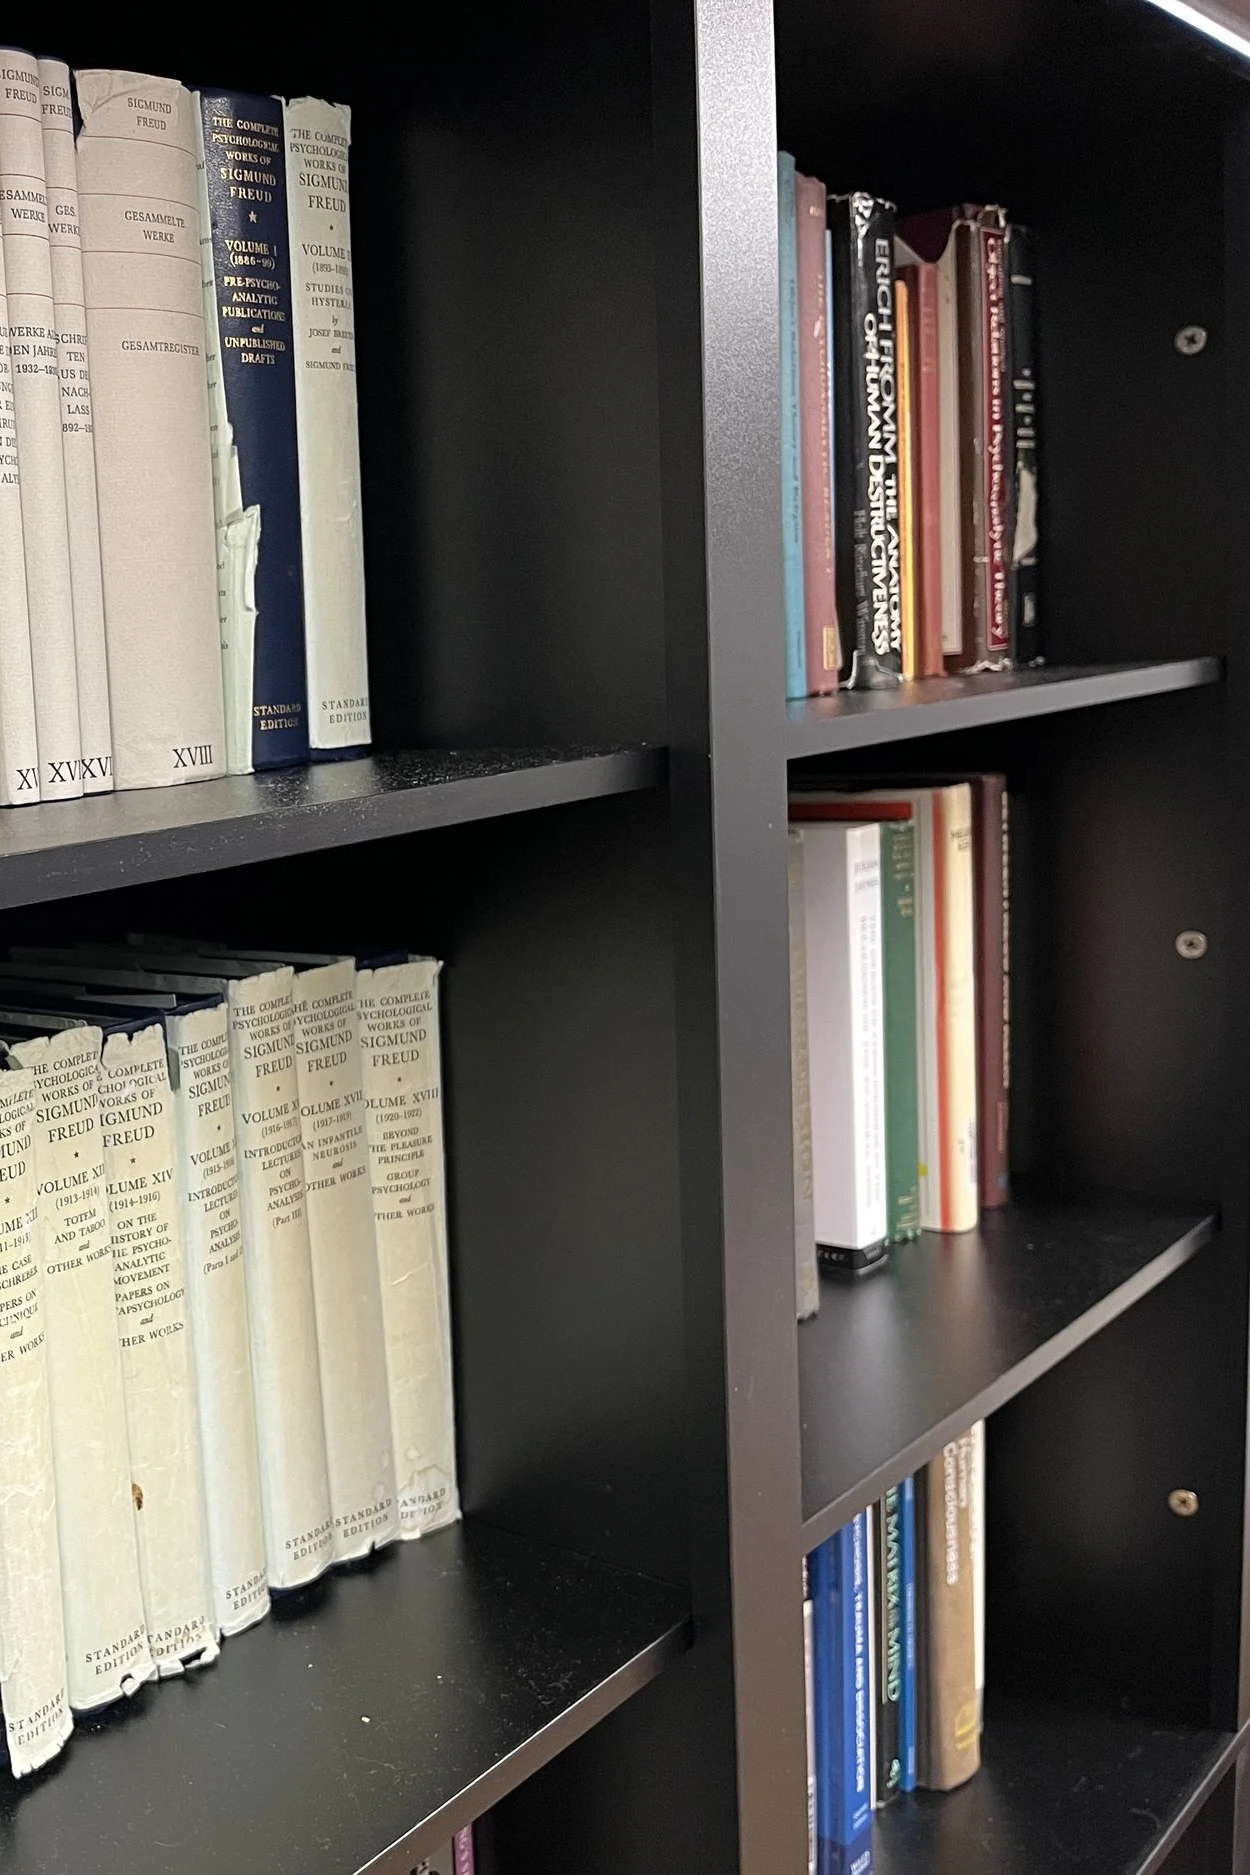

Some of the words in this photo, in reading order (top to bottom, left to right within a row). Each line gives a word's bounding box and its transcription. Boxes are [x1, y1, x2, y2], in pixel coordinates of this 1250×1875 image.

[5, 88, 37, 104] FREUD
[127, 98, 172, 114] SIGMUND
[136, 116, 166, 130] FREUD
[212, 117, 233, 128] THE
[237, 119, 279, 137] COMPLETE
[220, 167, 276, 186] SIGMUND
[230, 186, 272, 203] FREUD
[308, 195, 346, 213] FREUD
[125, 210, 185, 228] GESAMMELTE
[143, 229, 174, 243] WERKE
[225, 240, 270, 255] VOLUME
[875, 238, 893, 331] ERICH
[232, 292, 278, 305] ANALYTIC
[122, 340, 200, 356] GESAMTREGISTER
[225, 337, 285, 351] UNPUBLISHED
[242, 353, 275, 364] DRAFTS
[864, 350, 881, 450] HUMAN
[879, 339, 897, 464] FROMM
[67, 405, 90, 415] LASS
[884, 476, 898, 521] THE
[868, 455, 890, 655] DESTRUCTIVENESS
[254, 704, 301, 717] STANDARD
[330, 712, 367, 724] EDITION
[260, 718, 298, 730] EDITION
[172, 745, 213, 768] XVIII
[360, 1029, 427, 1048] SIGMUND
[372, 1049, 420, 1067] FREUD
[313, 1141, 357, 1161] NEUROSIS
[378, 1151, 425, 1165] PRINCIPLE
[64, 1208, 97, 1227] TOTEM
[54, 1231, 76, 1245] AND
[78, 1218, 106, 1237] TABOO
[114, 1252, 166, 1272] ANALYTIC
[343, 1513, 389, 1538] EDITION
[887, 1513, 899, 1609] MATRIX
[888, 1628, 900, 1701] MIND
